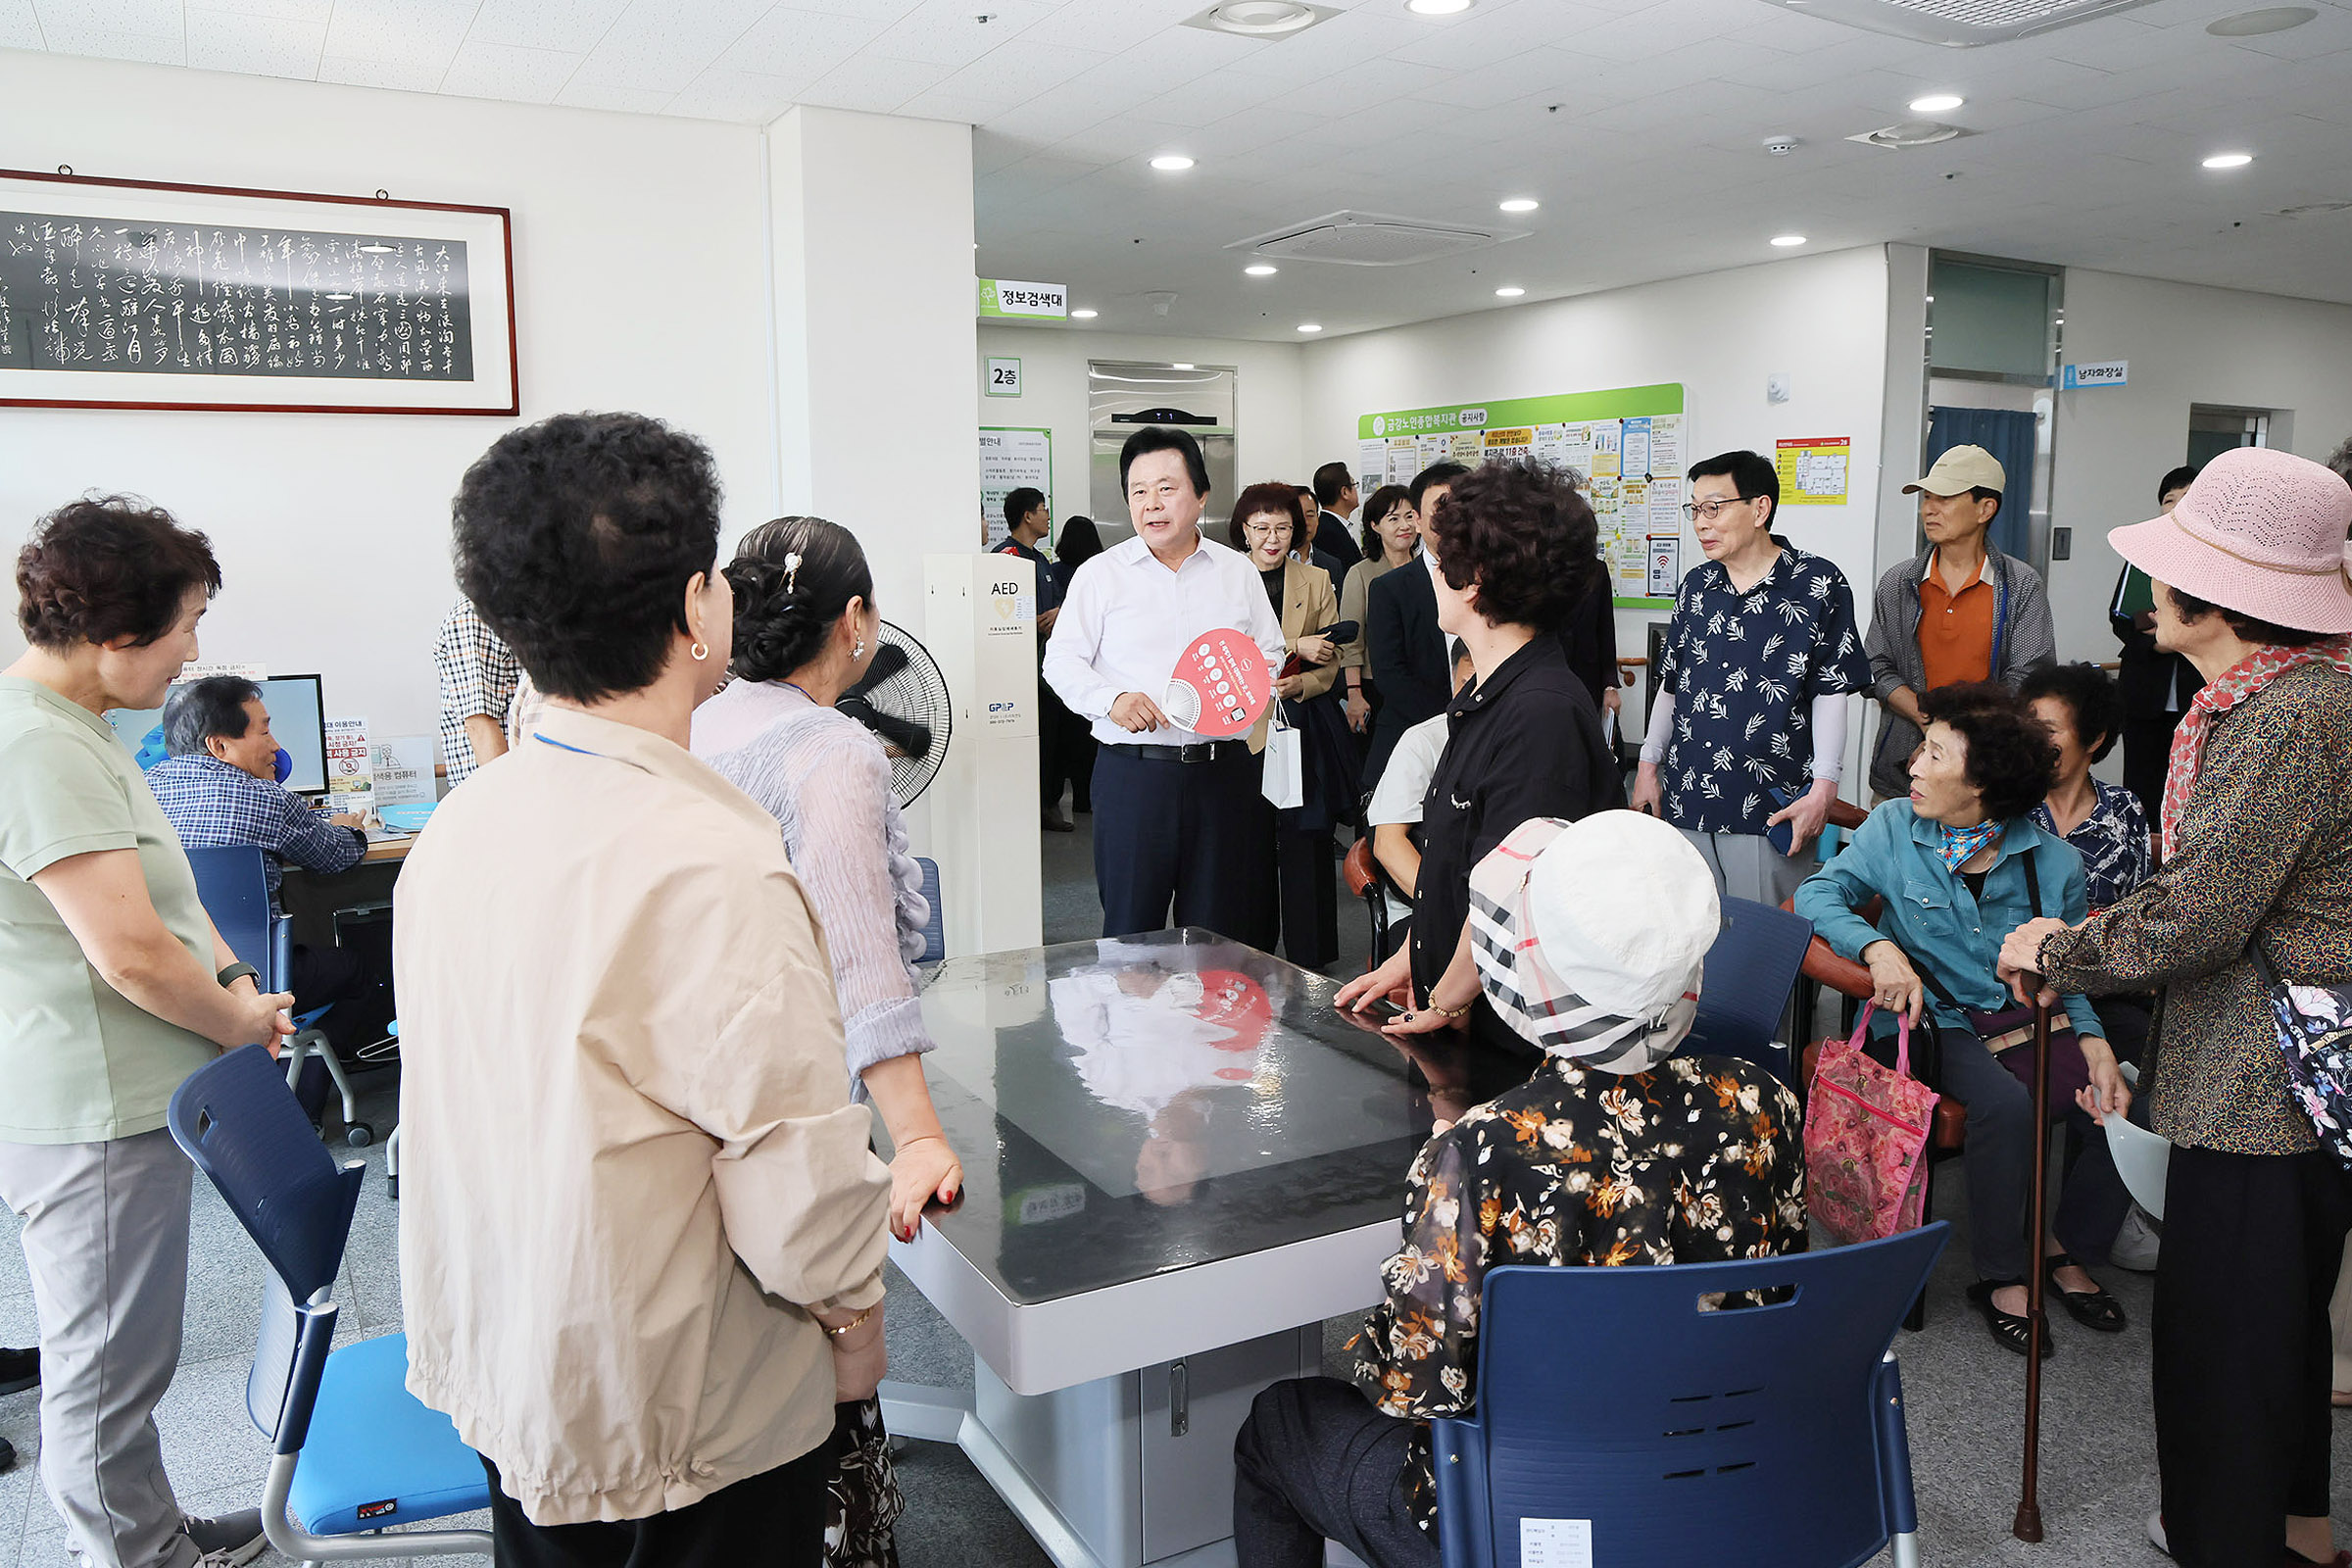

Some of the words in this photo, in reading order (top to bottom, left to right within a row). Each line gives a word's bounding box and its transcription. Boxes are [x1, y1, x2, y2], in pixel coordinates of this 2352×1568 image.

[1002, 290, 1063, 308] 정보검색대
[993, 368, 1016, 385] 2층
[2079, 367, 2124, 380] 남자화장실
[991, 582, 1018, 596] AED
[988, 702, 1014, 712] GP&P
[394, 770, 417, 780] 컴퓨터
